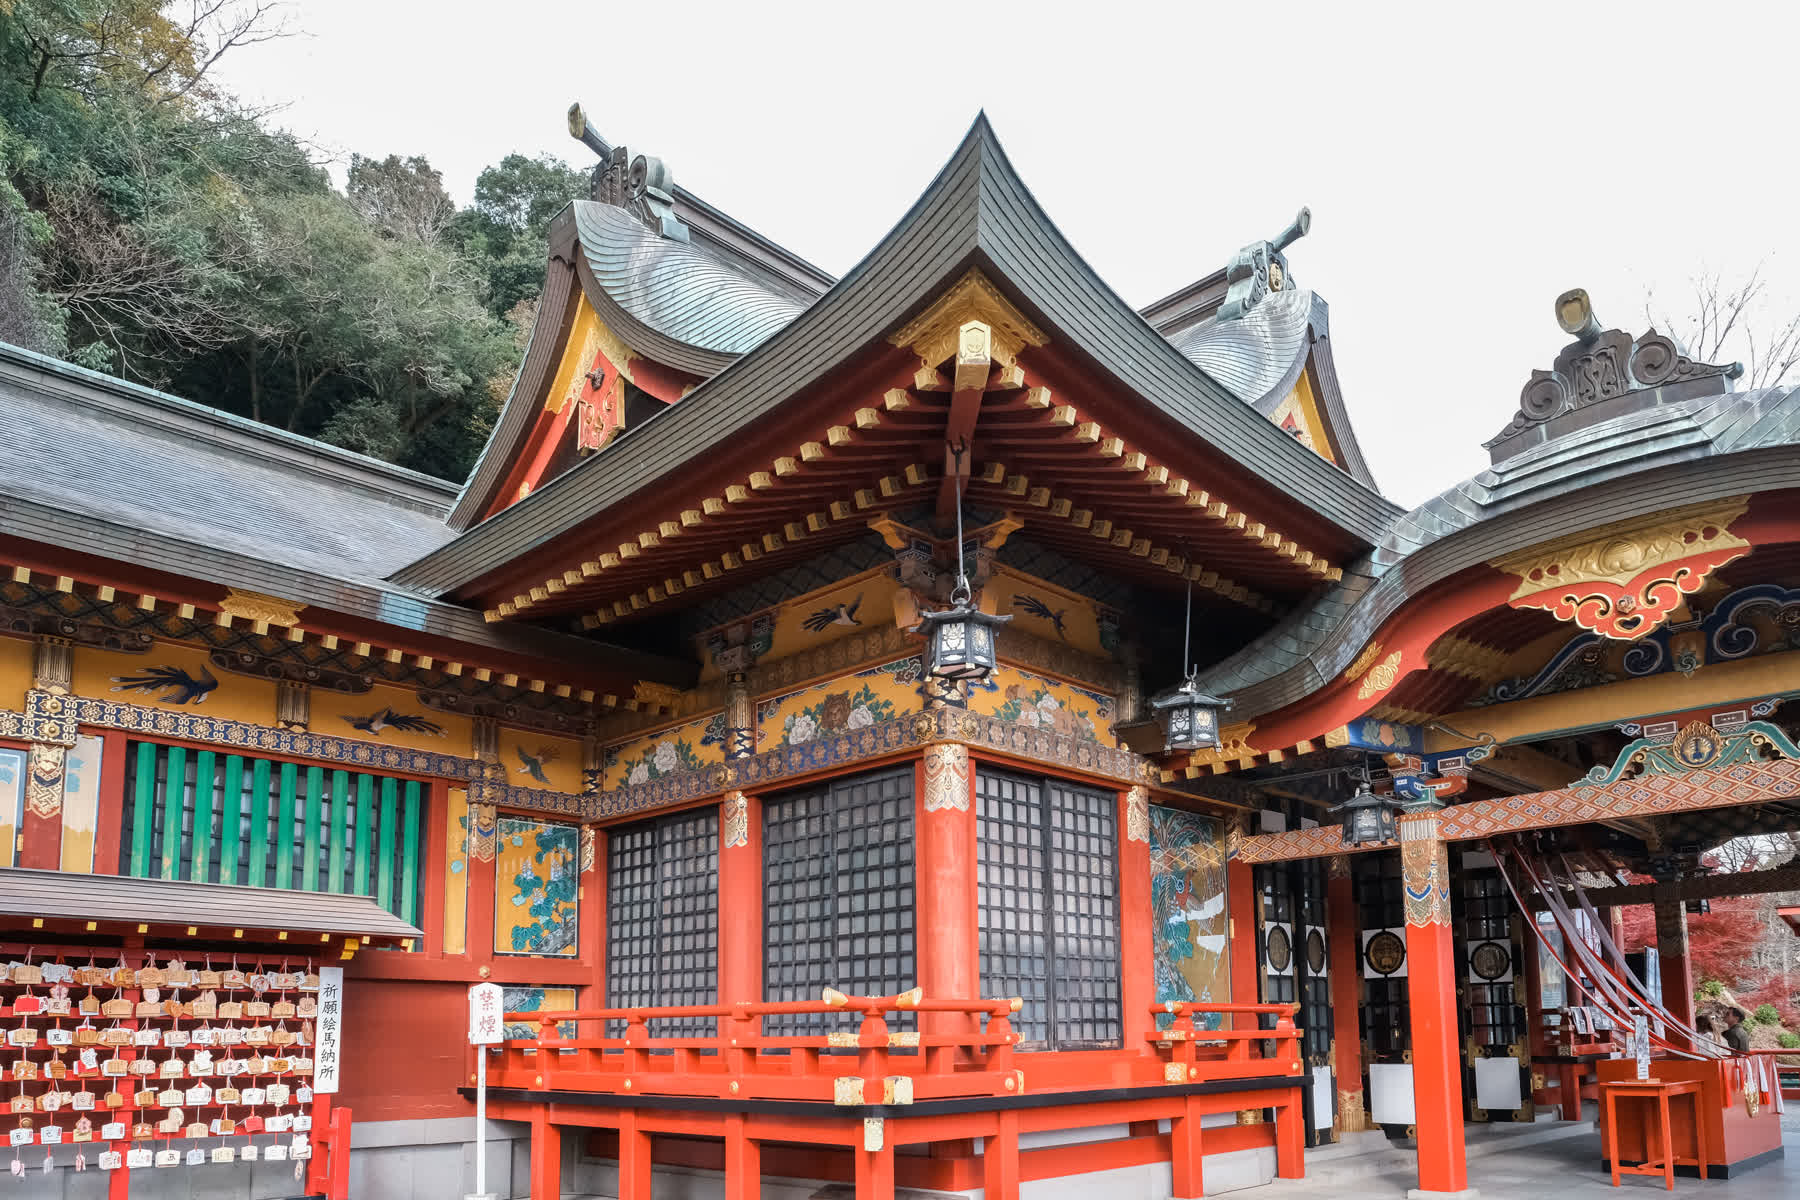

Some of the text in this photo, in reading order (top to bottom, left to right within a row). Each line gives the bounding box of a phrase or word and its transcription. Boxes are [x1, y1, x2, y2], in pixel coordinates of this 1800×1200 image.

[319, 983, 338, 1080] 祈願絵馬納所
[479, 989, 496, 1036] 禁煙
